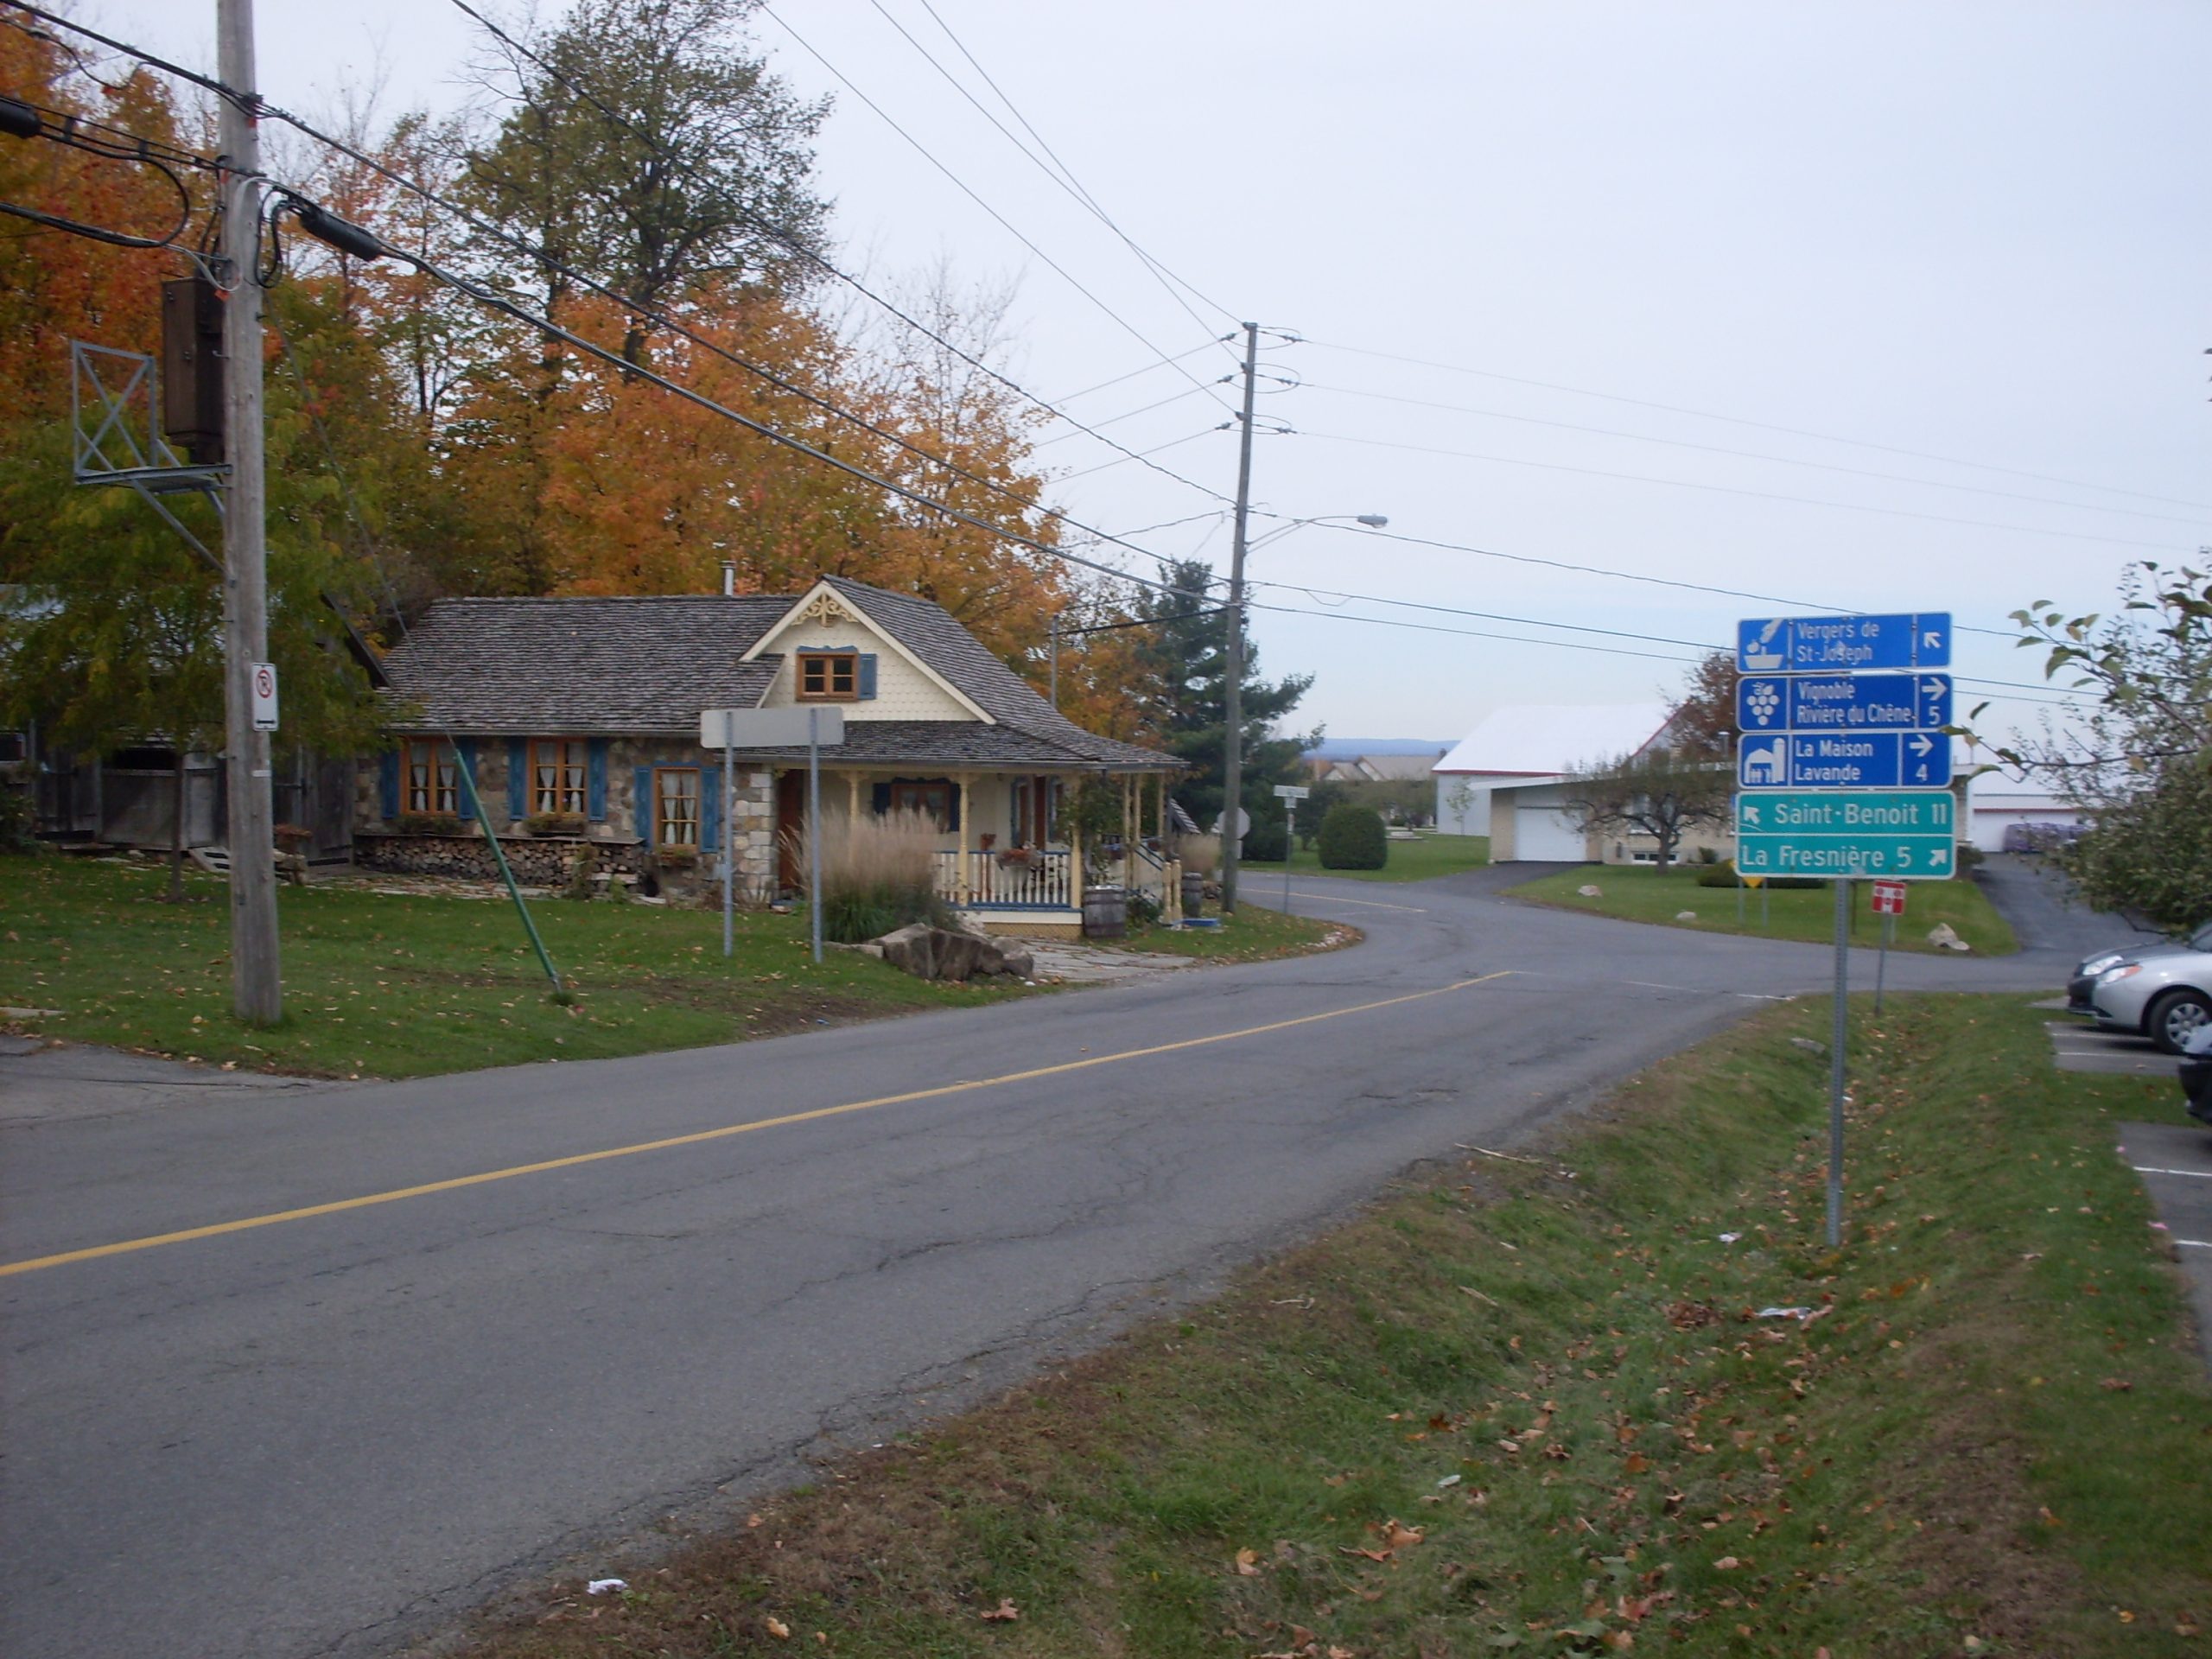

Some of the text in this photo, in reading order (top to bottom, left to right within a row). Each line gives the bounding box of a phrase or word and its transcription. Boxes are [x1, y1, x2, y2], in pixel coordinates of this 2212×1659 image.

[1796, 621, 1880, 644] Vergers de
[1796, 644, 1873, 665] St-Joseph
[1797, 681, 1855, 705] Vignoble
[1847, 704, 1866, 723] du
[1929, 706, 1941, 725] 5
[1795, 740, 1873, 757] La Maison
[1794, 764, 1861, 781] Lavande
[1916, 764, 1928, 781] 4
[1931, 805, 1947, 824] 11
[1742, 845, 1911, 868] La Fresnière 5
